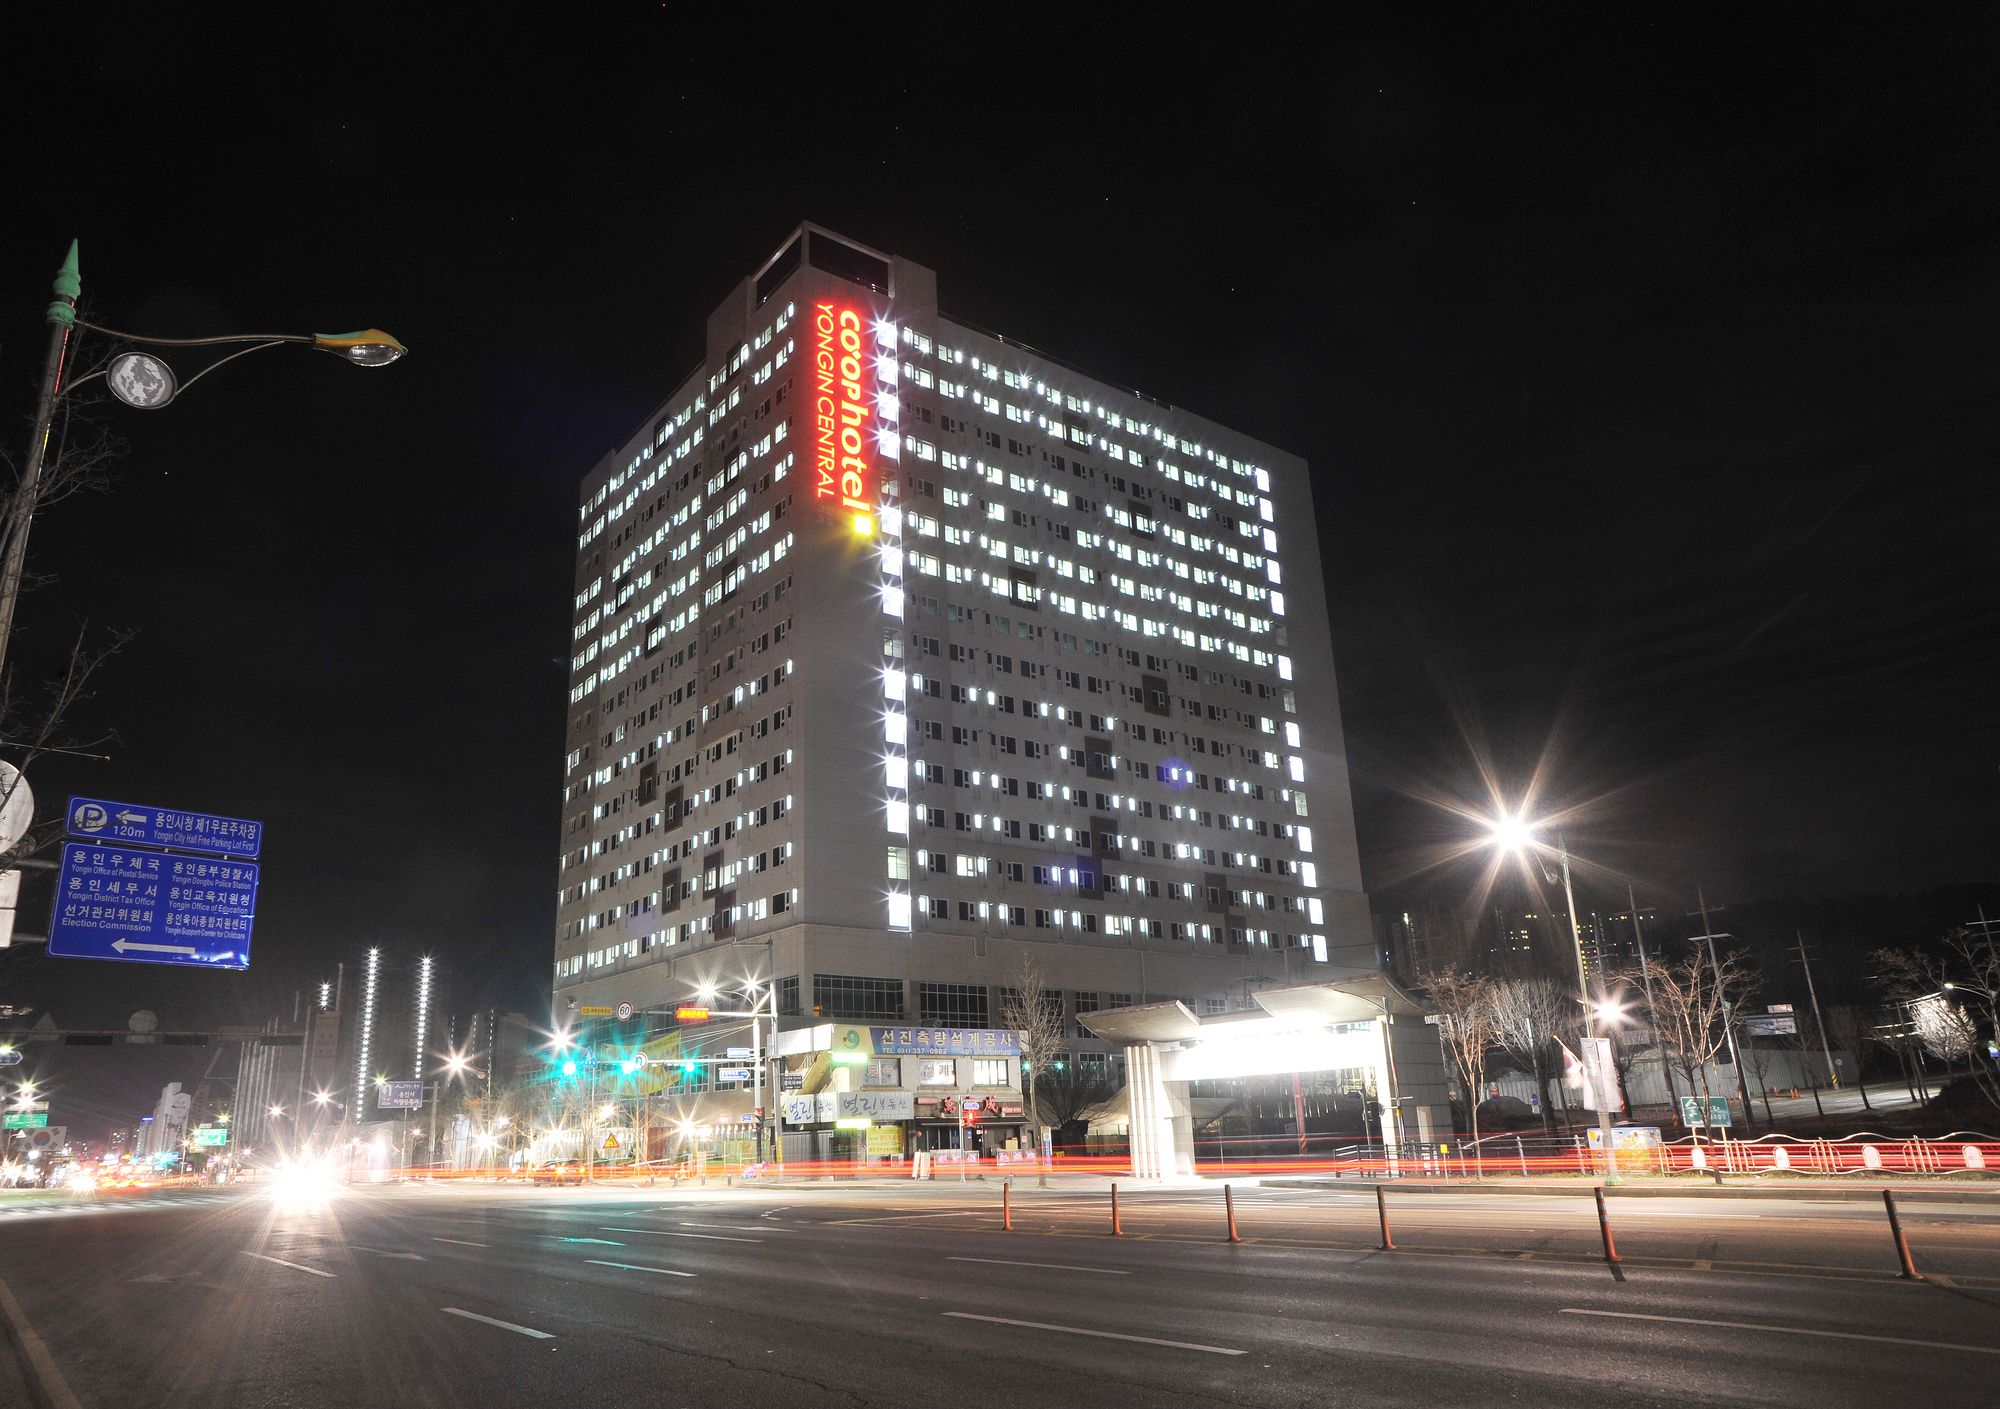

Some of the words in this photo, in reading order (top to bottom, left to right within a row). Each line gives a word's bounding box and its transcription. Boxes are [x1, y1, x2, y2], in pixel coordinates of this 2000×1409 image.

[816, 304, 835, 396] YONGIN
[816, 396, 835, 498] CENTRAL
[155, 812, 194, 831] 용인시청
[113, 825, 145, 838] 120m
[153, 829, 174, 843] Yongin
[174, 832, 186, 844] City
[187, 834, 198, 844] Hall
[198, 835, 211, 846] Free
[211, 837, 232, 850] Parking
[232, 840, 242, 849] Lot
[242, 840, 255, 851] First
[74, 851, 160, 871] 용인우체국
[72, 864, 92, 875] Yongin
[93, 866, 111, 876] Office
[111, 868, 118, 876] of
[118, 869, 137, 878] Postal
[137, 870, 159, 880] Service
[173, 862, 253, 881] 용인동부경찰서
[69, 877, 157, 897] 용인세무서
[172, 874, 192, 885] Yongin
[192, 876, 214, 887] Dongbu
[215, 879, 232, 888] Police
[232, 881, 252, 890] Station
[67, 890, 92, 902] Yongin
[94, 892, 119, 903] District
[121, 895, 133, 904] Tax
[135, 896, 156, 906] Office
[170, 887, 250, 906] 용인교육지원청
[64, 904, 153, 922] 선거관리위원회
[168, 899, 190, 911] Yongin
[191, 901, 210, 911] Office
[210, 903, 218, 911] of
[218, 904, 248, 915] Education
[62, 917, 98, 929] Election
[99, 919, 152, 932] Commission
[166, 913, 247, 931] 용인육아종합지원센터
[164, 926, 182, 936] Yongin
[181, 927, 200, 937] Support
[620, 1006, 630, 1015] 60
[881, 1030, 1012, 1047] 선진측량설계공사
